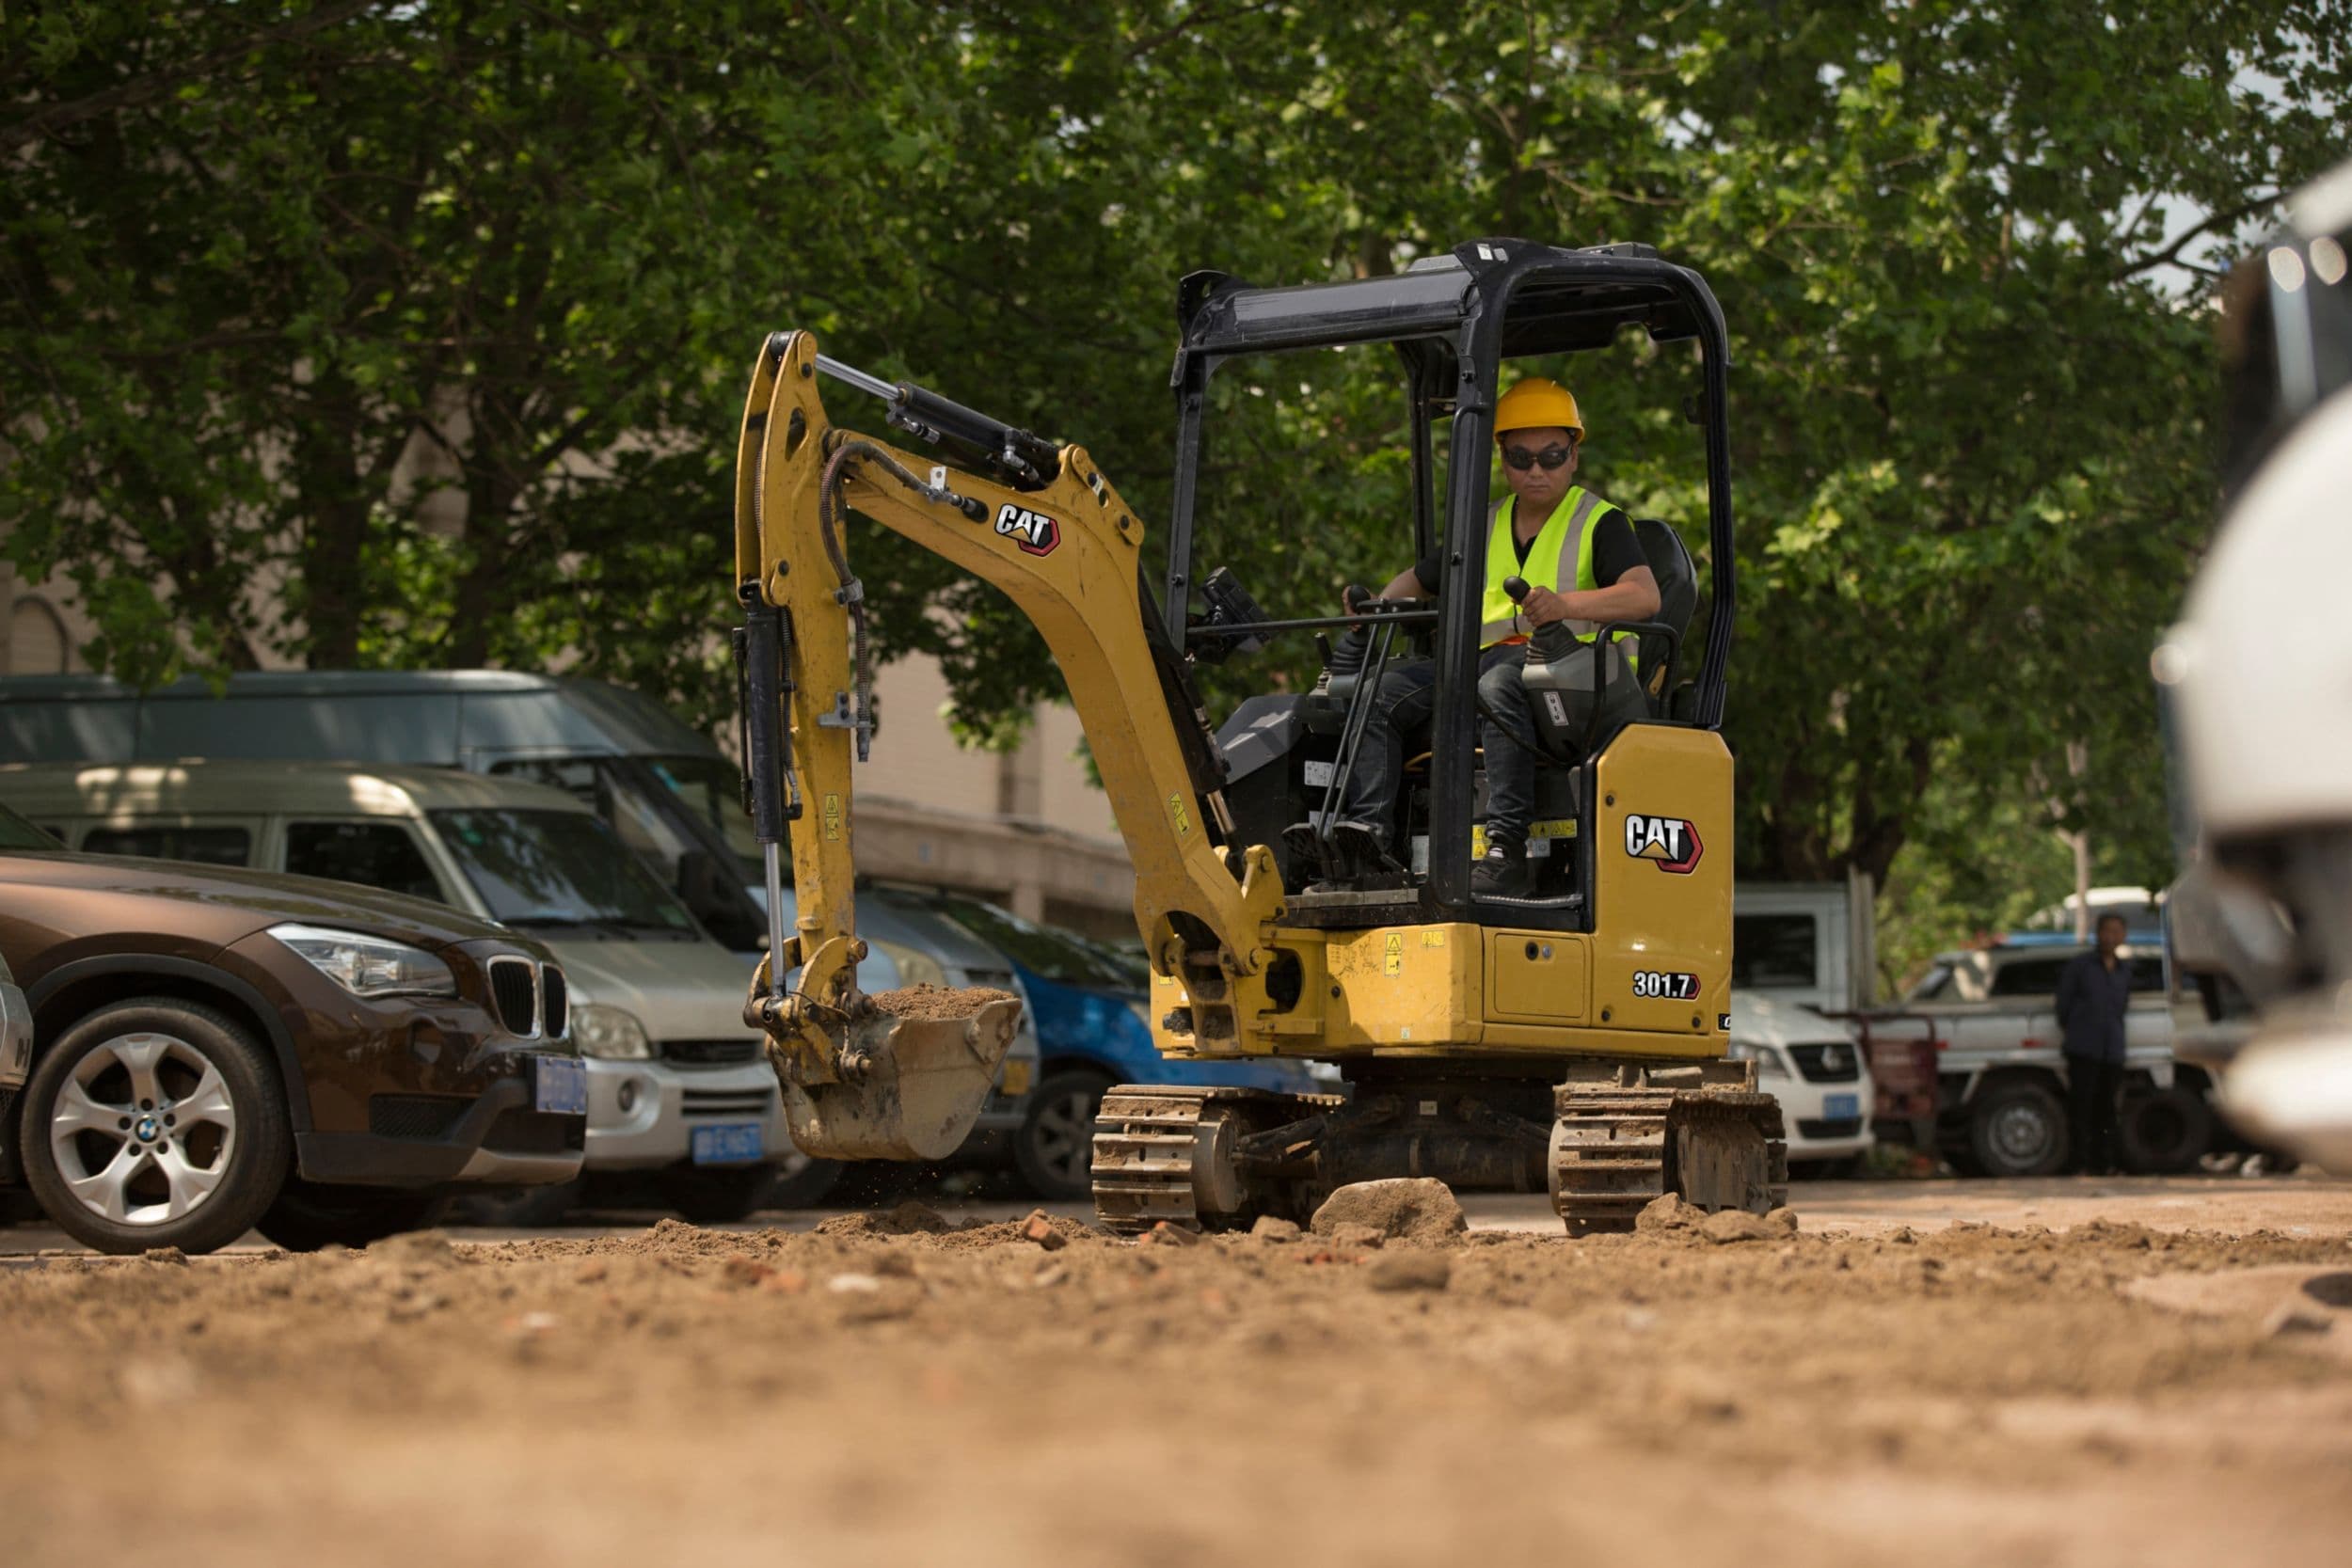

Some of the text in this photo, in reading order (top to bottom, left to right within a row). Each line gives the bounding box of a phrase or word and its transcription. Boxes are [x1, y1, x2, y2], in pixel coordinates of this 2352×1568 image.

[995, 504, 1050, 546] CAT
[1626, 815, 1684, 860] CAT
[1634, 972, 1690, 998] 301.7
